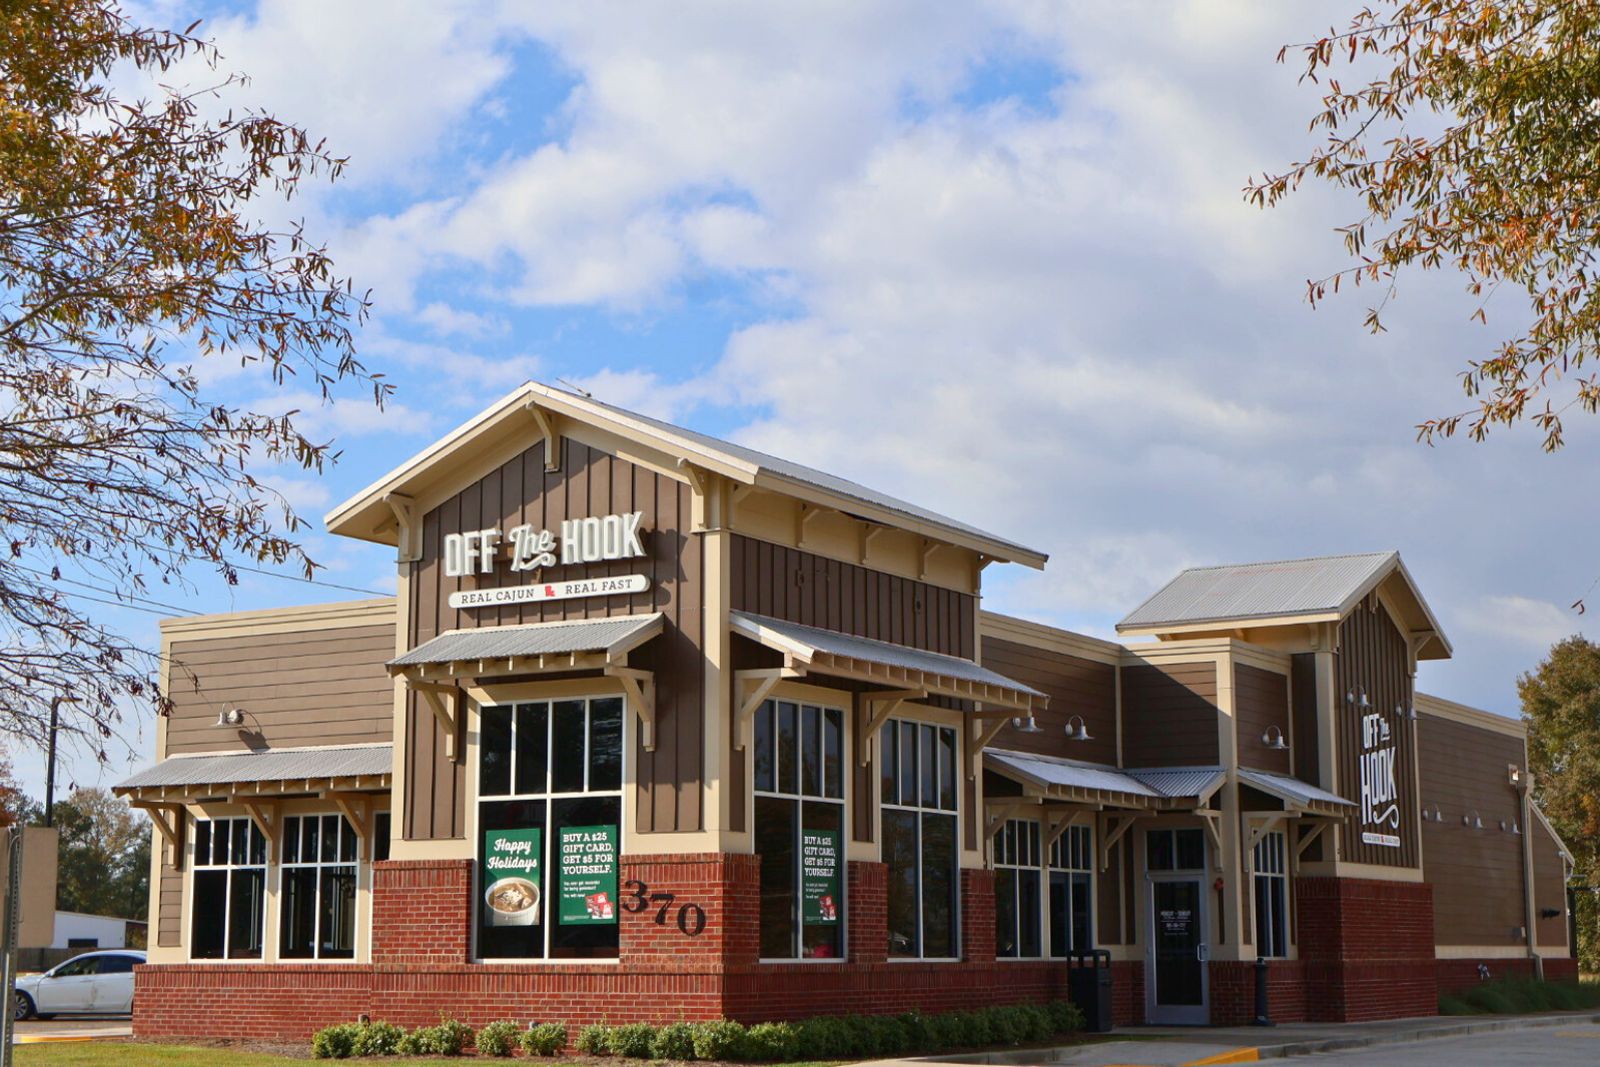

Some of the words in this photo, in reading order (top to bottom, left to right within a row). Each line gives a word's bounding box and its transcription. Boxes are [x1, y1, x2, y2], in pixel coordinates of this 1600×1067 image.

[444, 528, 502, 577] OFF
[508, 523, 557, 572] The
[560, 510, 647, 565] HOOK
[461, 592, 492, 604] REAL
[495, 588, 535, 601] CAJUN
[565, 582, 598, 595] REAL
[602, 579, 633, 591] FAST
[1362, 713, 1380, 749] OFF
[1360, 746, 1398, 826] HOOK
[563, 833, 582, 842] BUY
[583, 833, 590, 842] A
[591, 832, 607, 842] $25
[805, 836, 816, 845] BUY
[493, 838, 532, 855] Happy
[563, 844, 584, 853] GIFT
[585, 842, 614, 852] CARD,
[487, 856, 538, 873] Holidays
[563, 855, 581, 864] GET
[582, 854, 593, 864] $5
[594, 853, 613, 863] FOR
[563, 864, 612, 875] YOURSELF.
[623, 880, 706, 937] 370
